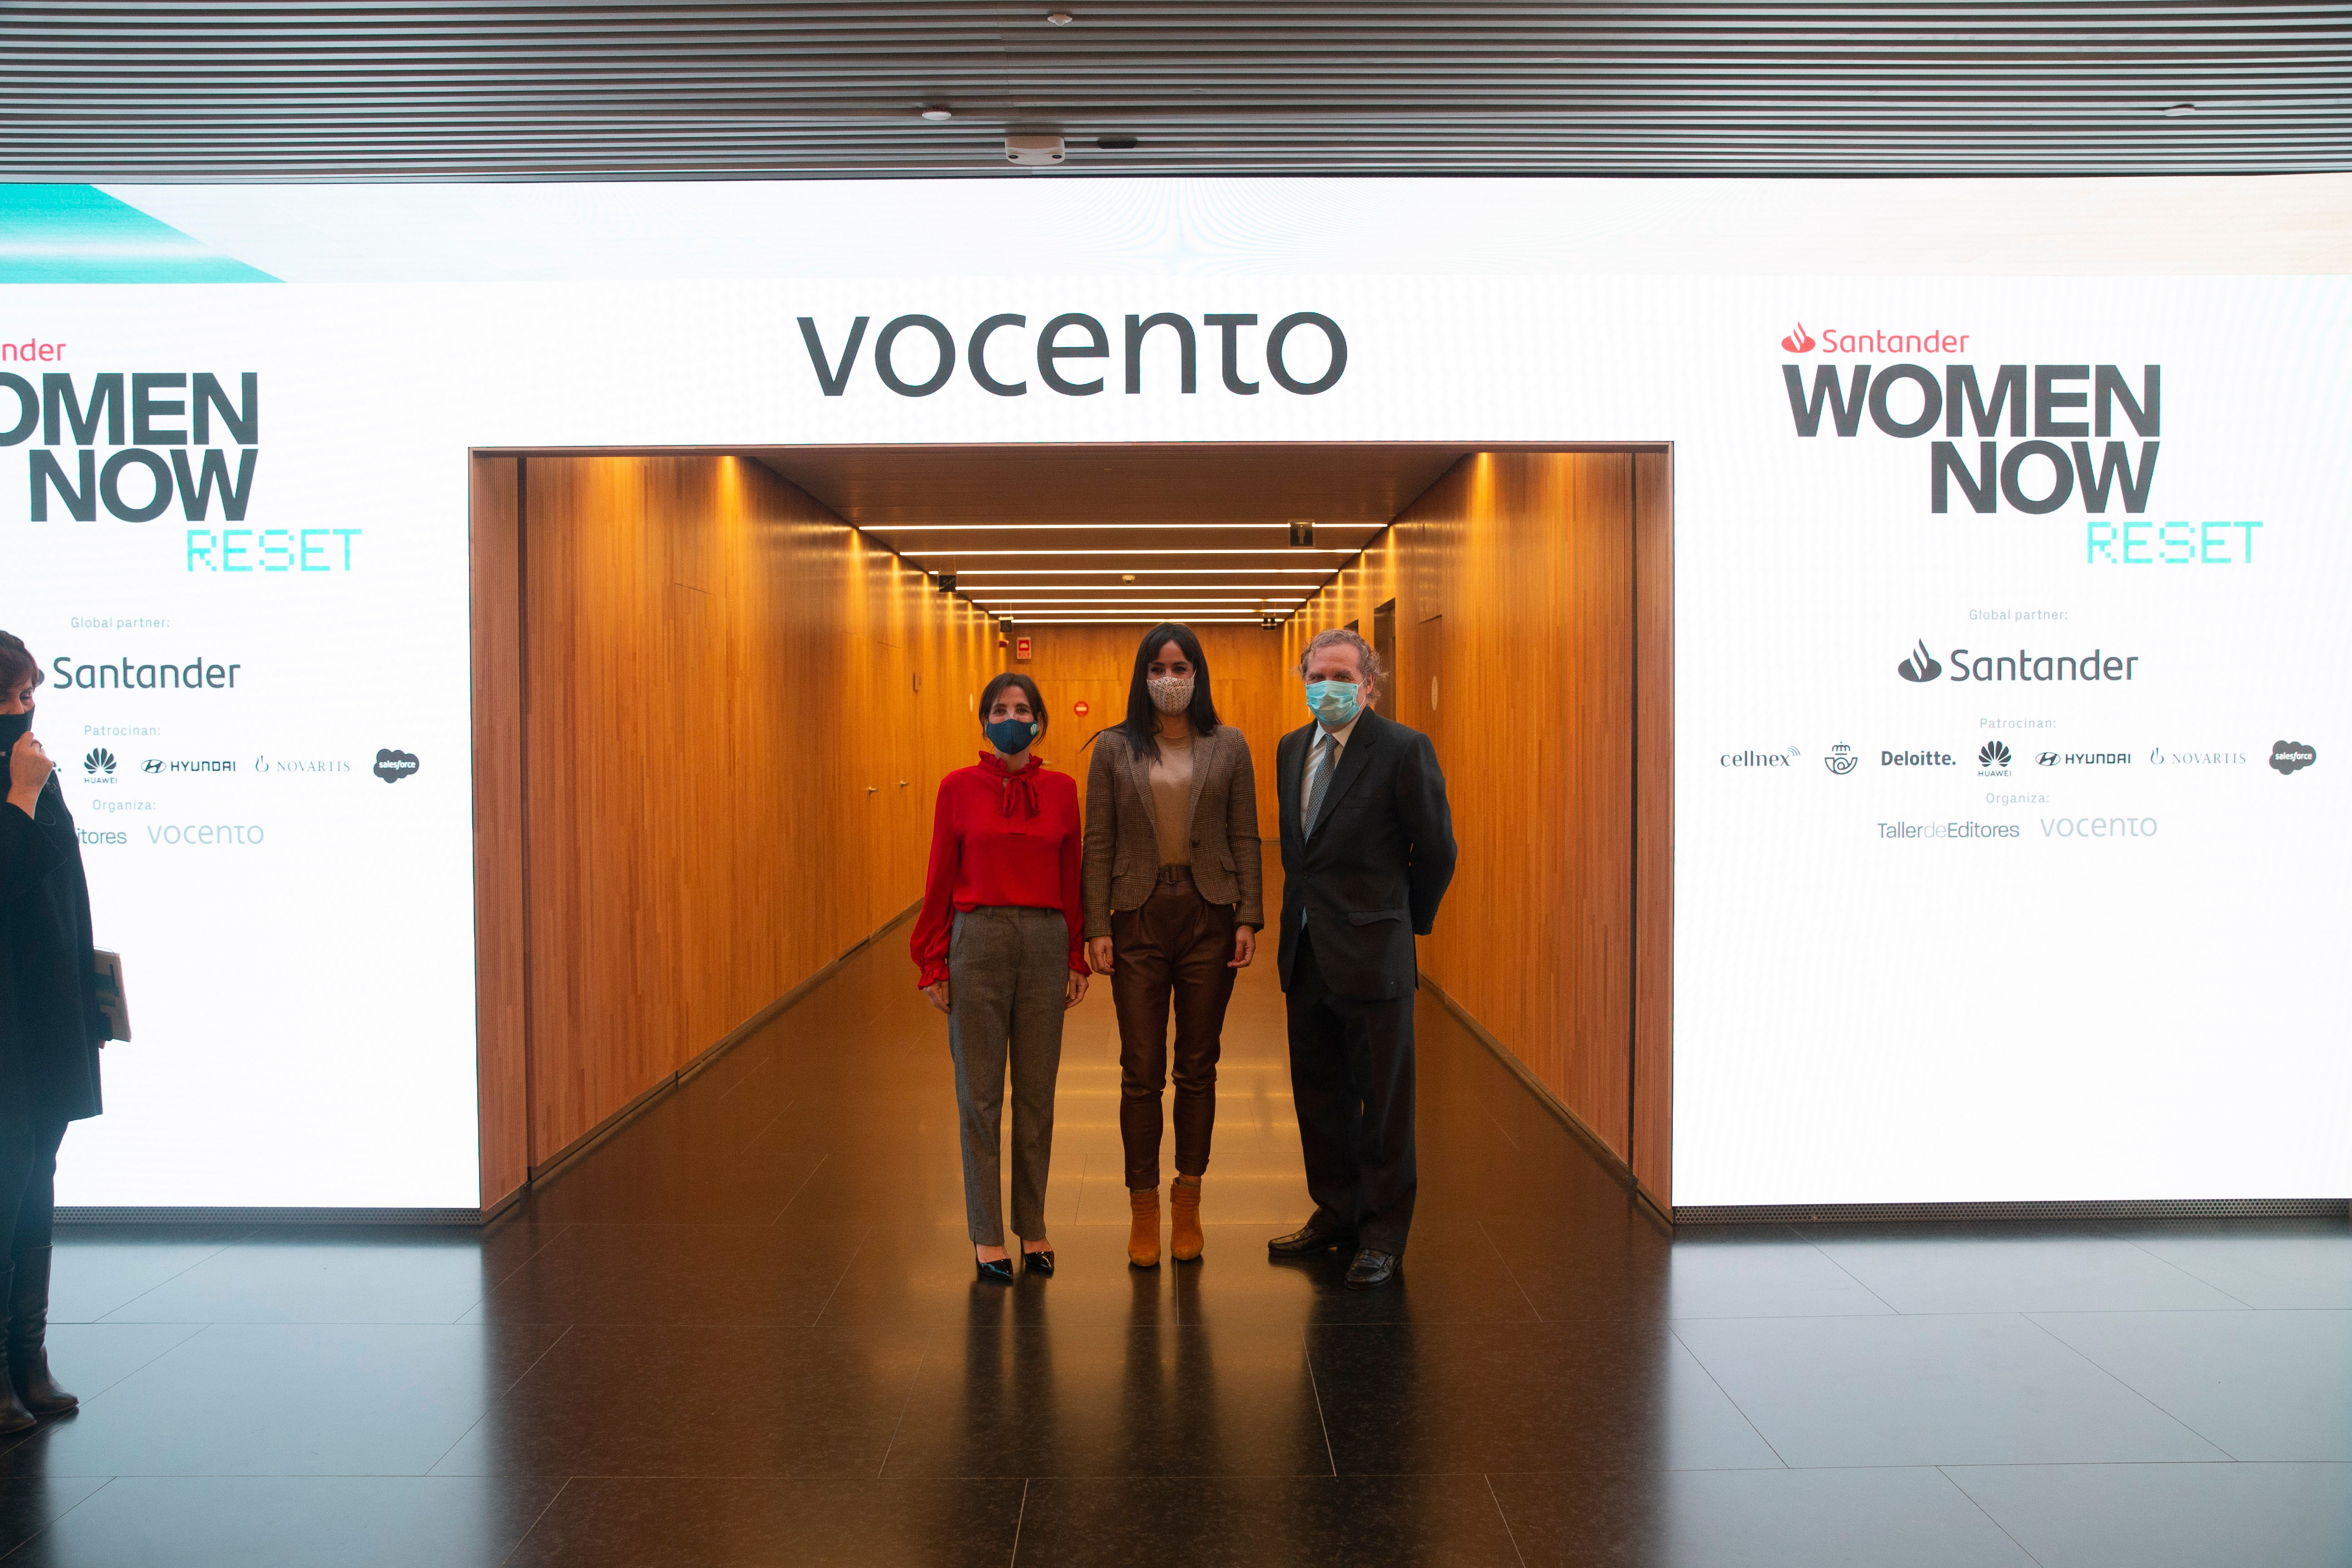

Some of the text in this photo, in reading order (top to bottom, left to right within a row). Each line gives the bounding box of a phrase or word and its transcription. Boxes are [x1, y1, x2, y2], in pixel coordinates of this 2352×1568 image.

[1823, 329, 1970, 353] Santander
[797, 312, 1348, 397] vocento
[1782, 363, 2161, 439] WOMEN
[29, 448, 259, 523] NOW
[1931, 440, 2161, 515] NOW
[187, 529, 362, 572] RESET
[2087, 521, 2264, 564] RESET
[70, 617, 170, 630] Global partner:
[1969, 609, 2068, 622] Global partner:
[53, 657, 240, 689] Santander
[1950, 649, 2139, 681] Santander
[84, 725, 161, 736] Patrocinan:
[1980, 718, 2056, 729] Patrocinan:
[1720, 750, 1791, 767] cellnex
[1882, 750, 1956, 766] Deloitte.
[2065, 753, 2131, 764] HYUNDAI
[2173, 753, 2246, 764] NOVARTIS
[2274, 751, 2313, 762] salesforce
[171, 761, 235, 772] HYUNDAI
[277, 761, 350, 772] NOVARTIS
[379, 760, 416, 770] salesforce
[93, 799, 156, 813] Organiza:
[1986, 793, 2049, 806] Organiza:
[147, 825, 264, 844] vocento
[1877, 817, 2158, 838] TallerdeEditores vocento
